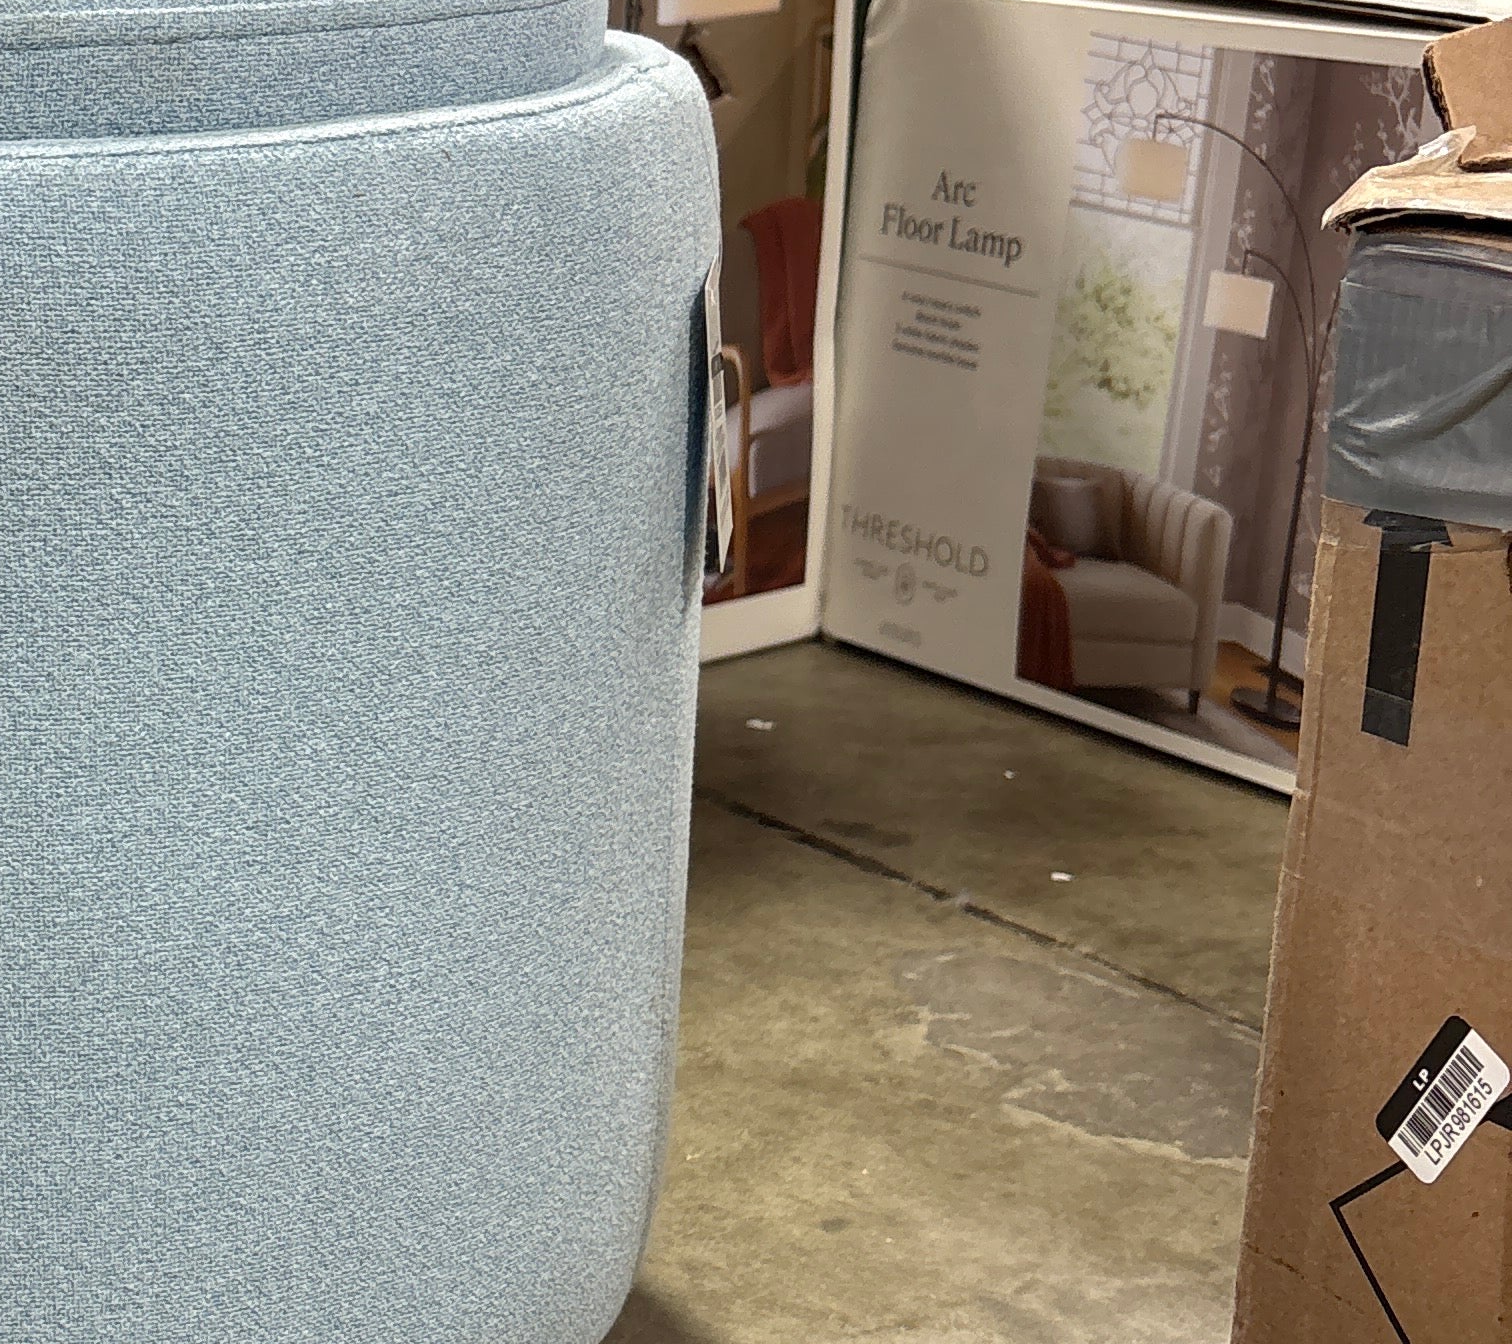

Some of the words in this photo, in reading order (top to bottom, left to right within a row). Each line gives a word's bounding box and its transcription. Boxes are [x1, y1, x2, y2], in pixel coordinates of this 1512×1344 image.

[931, 168, 979, 207] Arc
[879, 202, 944, 245] Floor
[948, 215, 1023, 268] Lamp
[842, 504, 990, 578] THRESHOLD
[1412, 1068, 1430, 1092] LP
[1423, 1077, 1493, 1166] LPJR981615
